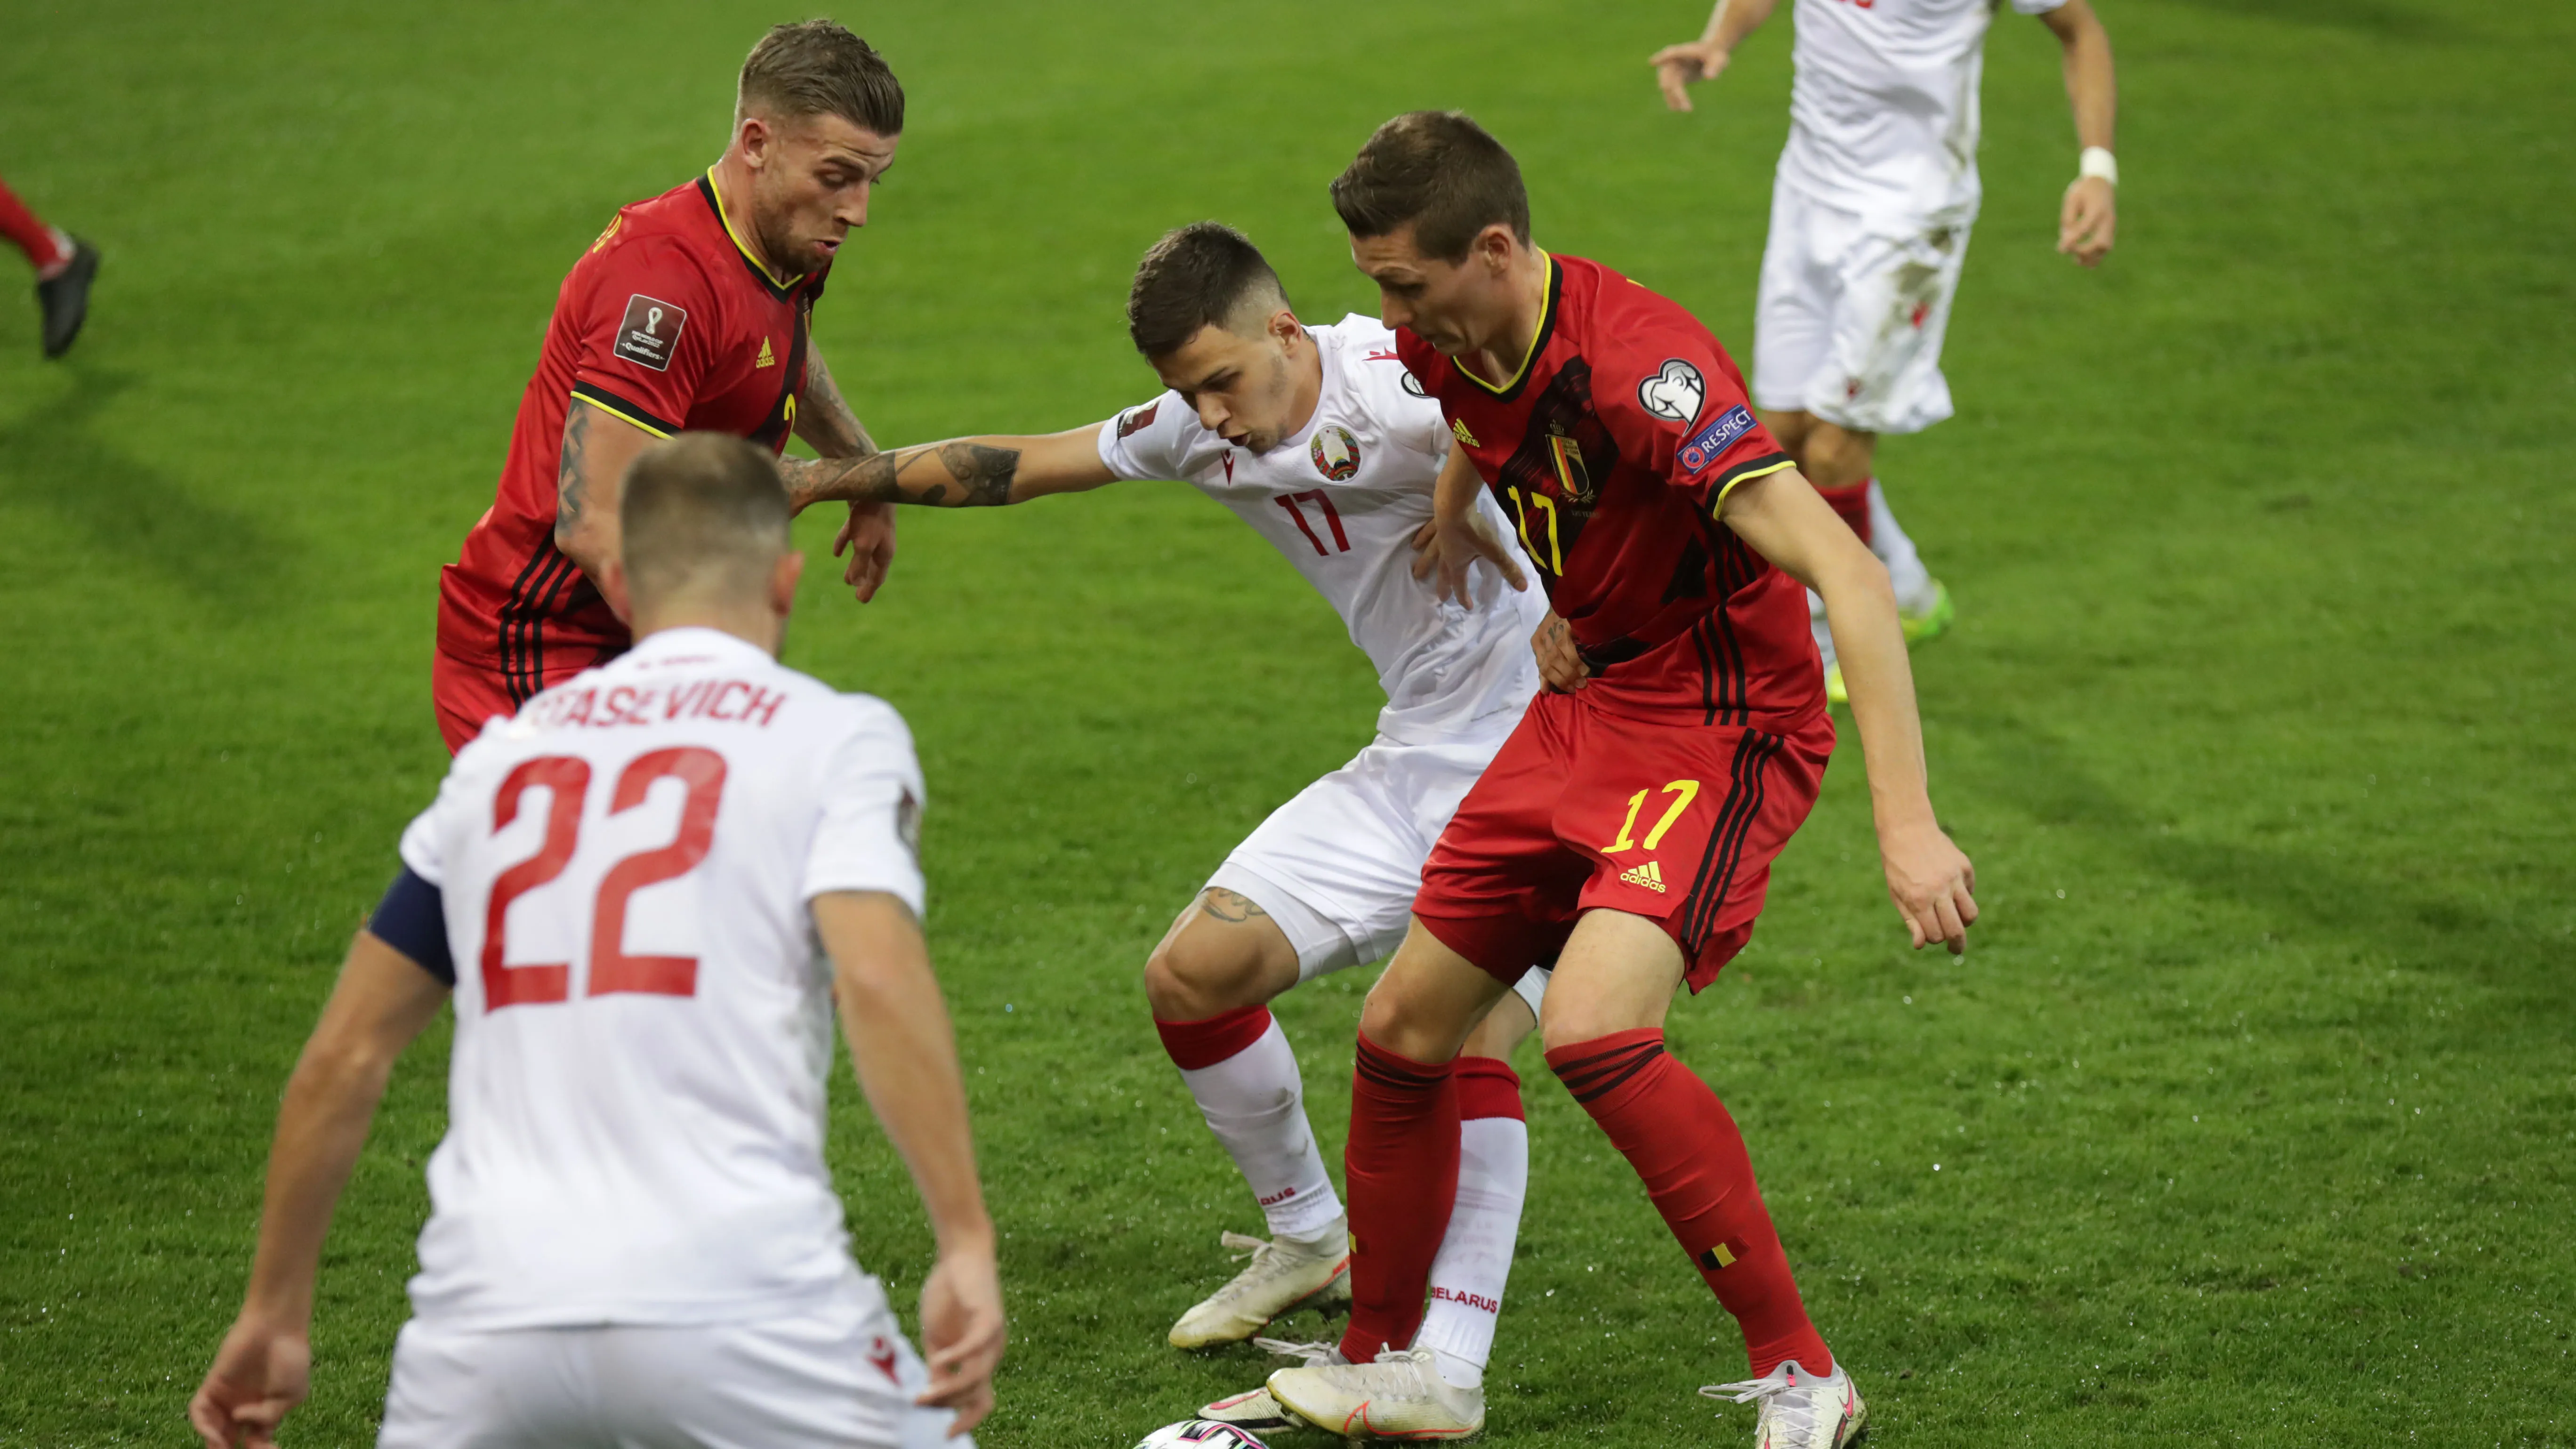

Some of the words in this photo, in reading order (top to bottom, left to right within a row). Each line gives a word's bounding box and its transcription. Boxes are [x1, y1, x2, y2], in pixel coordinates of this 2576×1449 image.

[625, 342, 660, 360] Qualifiers
[1701, 410, 1751, 453] RESPECT
[1273, 488, 1351, 556] 17
[1507, 485, 1563, 577] 17
[1601, 780, 1700, 853] 17
[480, 745, 729, 1015] 22
[1620, 872, 1666, 893] adidas
